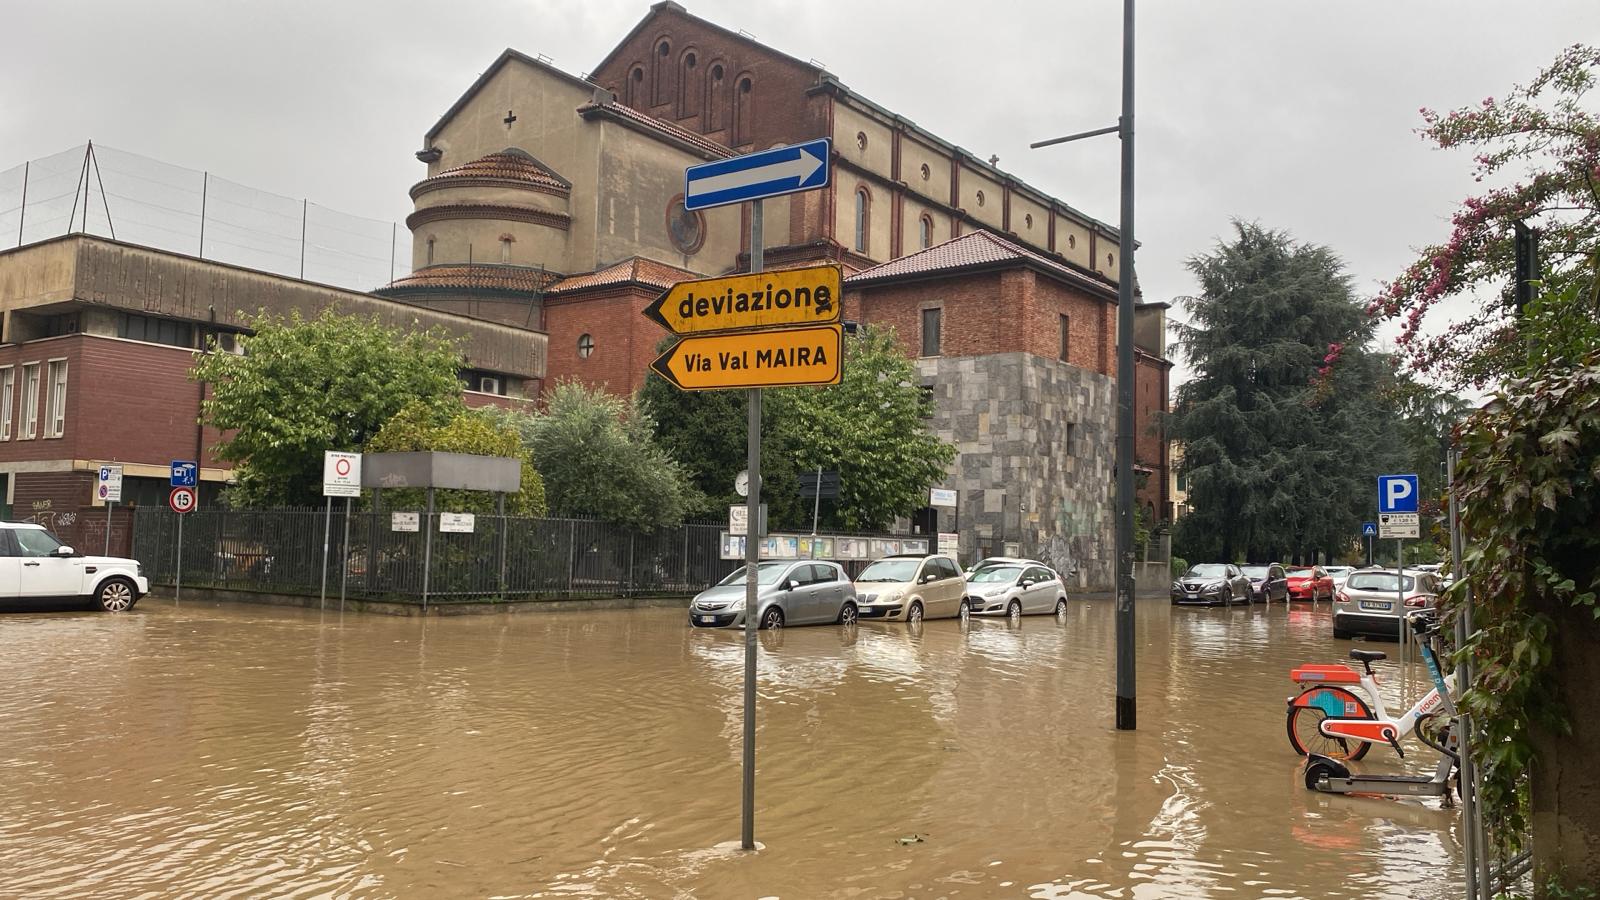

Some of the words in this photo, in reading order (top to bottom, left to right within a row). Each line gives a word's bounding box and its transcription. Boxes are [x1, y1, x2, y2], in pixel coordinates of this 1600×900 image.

[679, 284, 832, 319] deviazione
[685, 354, 711, 372] Via
[719, 351, 748, 370] Val
[757, 346, 827, 369] MAIRA
[177, 494, 189, 506] 15
[1387, 479, 1412, 509] P
[1426, 657, 1441, 684] BIRD
